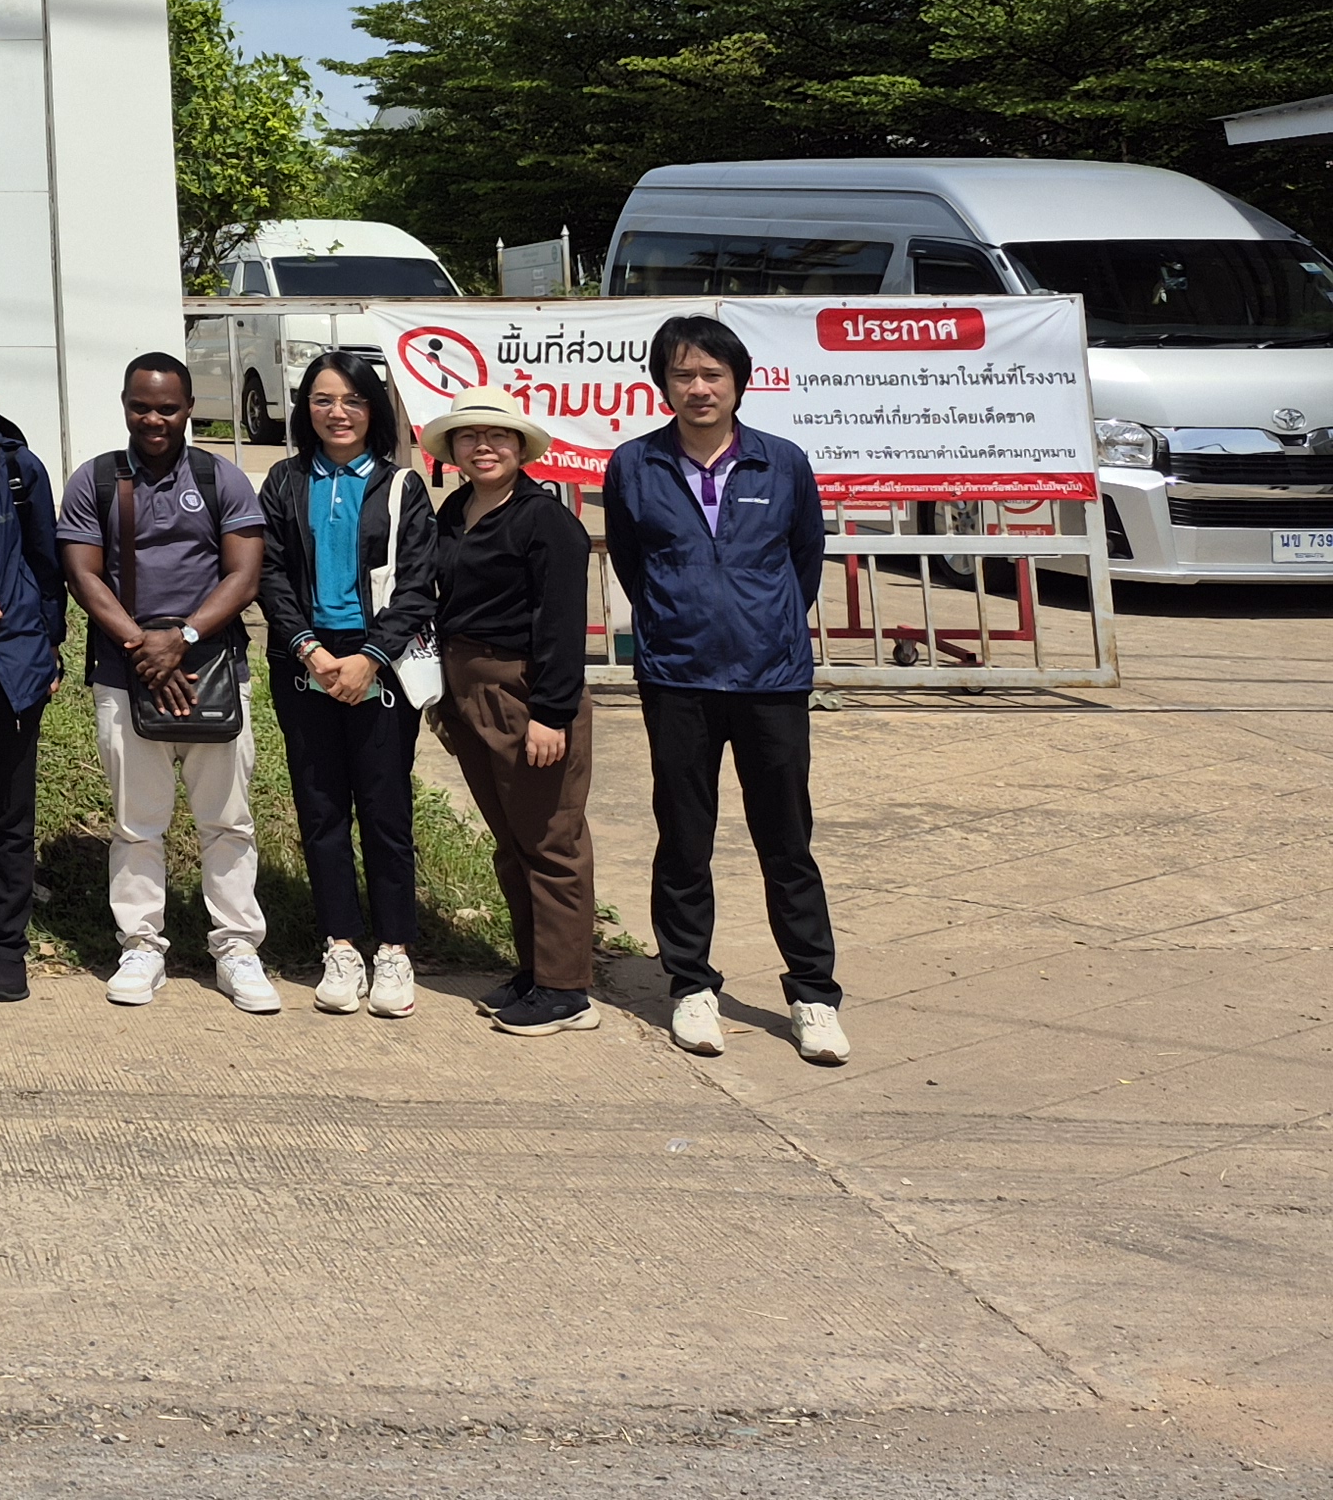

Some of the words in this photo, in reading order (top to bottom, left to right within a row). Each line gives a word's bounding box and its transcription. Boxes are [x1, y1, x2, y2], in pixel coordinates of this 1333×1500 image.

[843, 314, 958, 342] ประกาศ
[497, 323, 648, 373] พื้นที่ส่วนบุ
